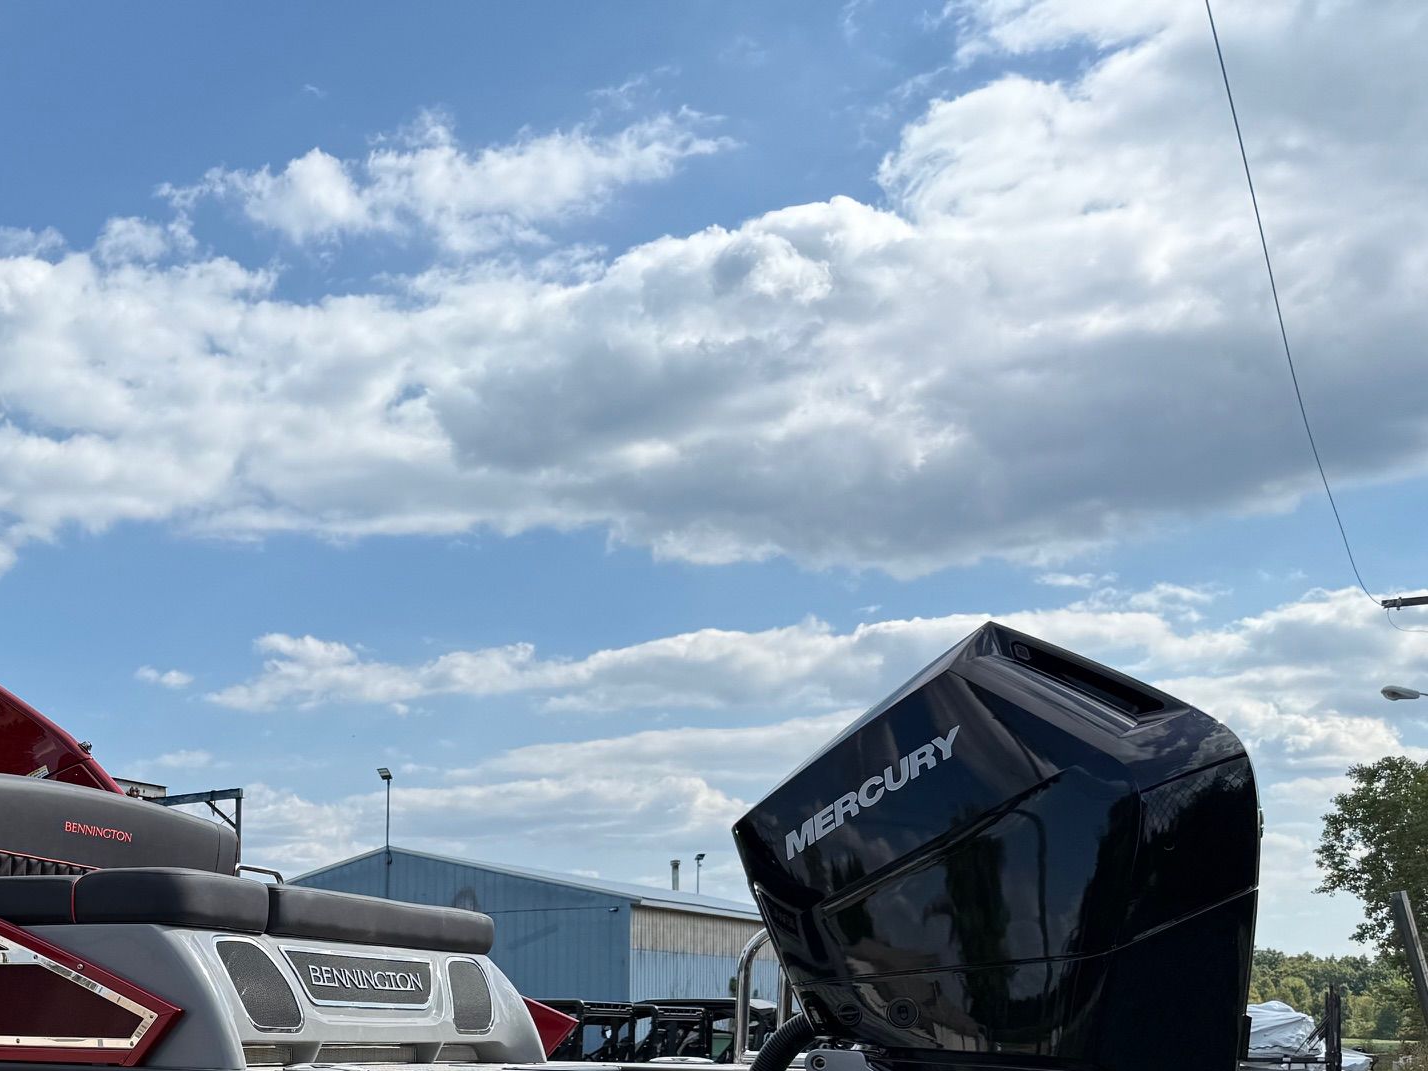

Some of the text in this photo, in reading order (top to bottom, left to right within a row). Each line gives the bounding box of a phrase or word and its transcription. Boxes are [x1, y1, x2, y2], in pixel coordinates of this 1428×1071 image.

[785, 725, 960, 861] MERCURY
[64, 821, 133, 843] BENNINGTON
[308, 964, 423, 992] BENNINGTON
